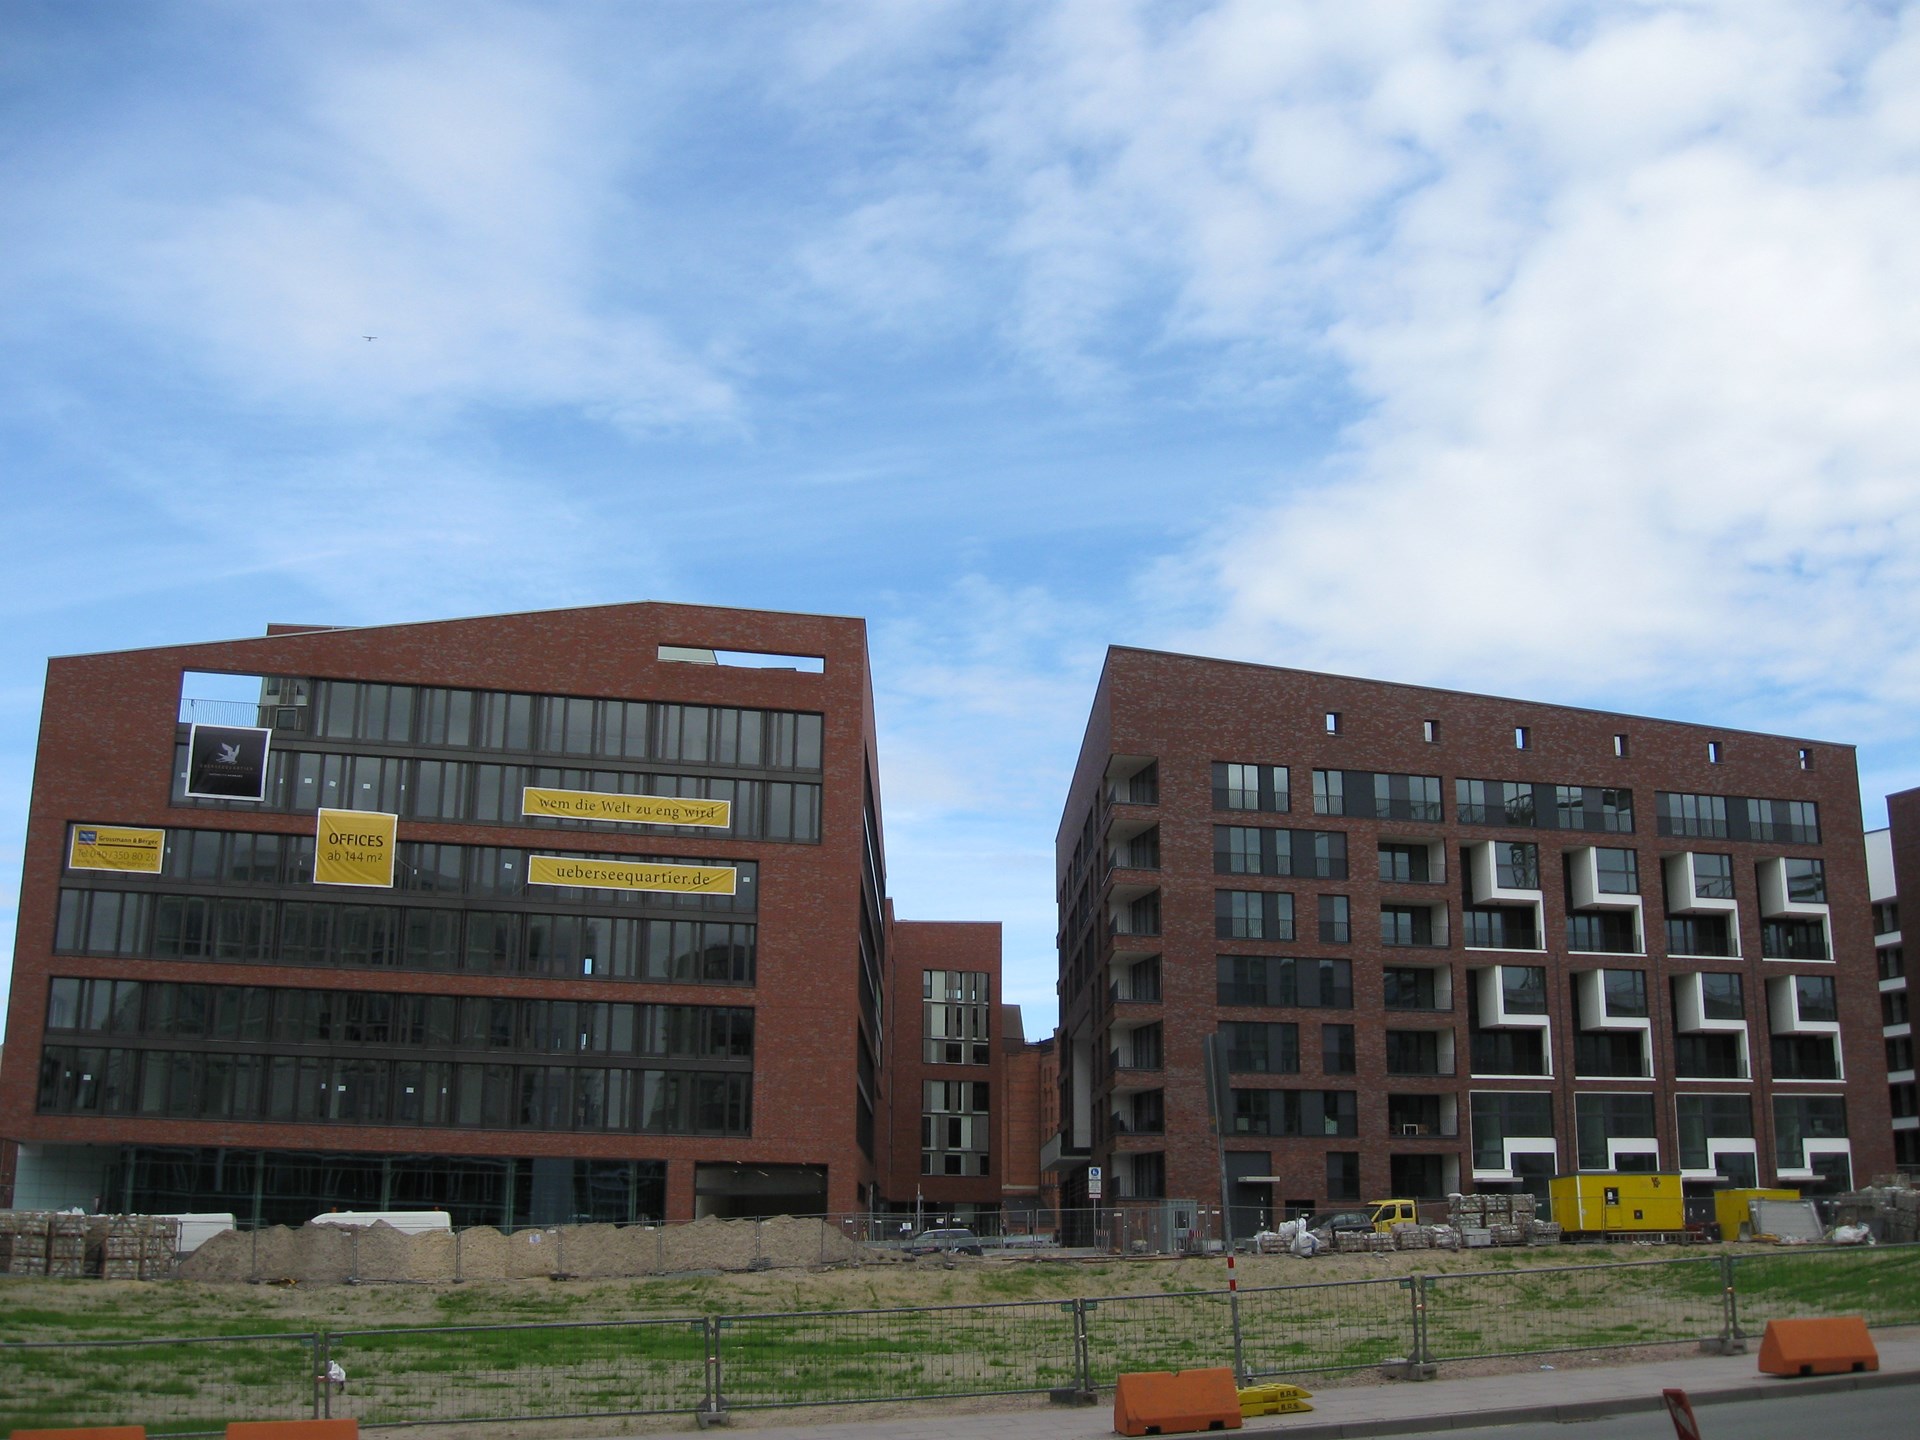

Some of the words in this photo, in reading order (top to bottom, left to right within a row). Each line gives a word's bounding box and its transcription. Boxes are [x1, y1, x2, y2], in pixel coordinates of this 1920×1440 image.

[539, 798, 570, 810] wem
[575, 798, 596, 811] die
[601, 800, 631, 814] Welt
[636, 805, 651, 815] zu
[656, 806, 680, 819] eng
[684, 806, 715, 819] wird
[98, 835, 132, 843] Grossmann
[137, 837, 158, 845] Berger
[328, 832, 384, 847] OFFICES
[131, 852, 143, 860] 80
[327, 849, 341, 861] ab
[345, 851, 364, 862] 144
[556, 865, 711, 885] ueberseequartier.de
